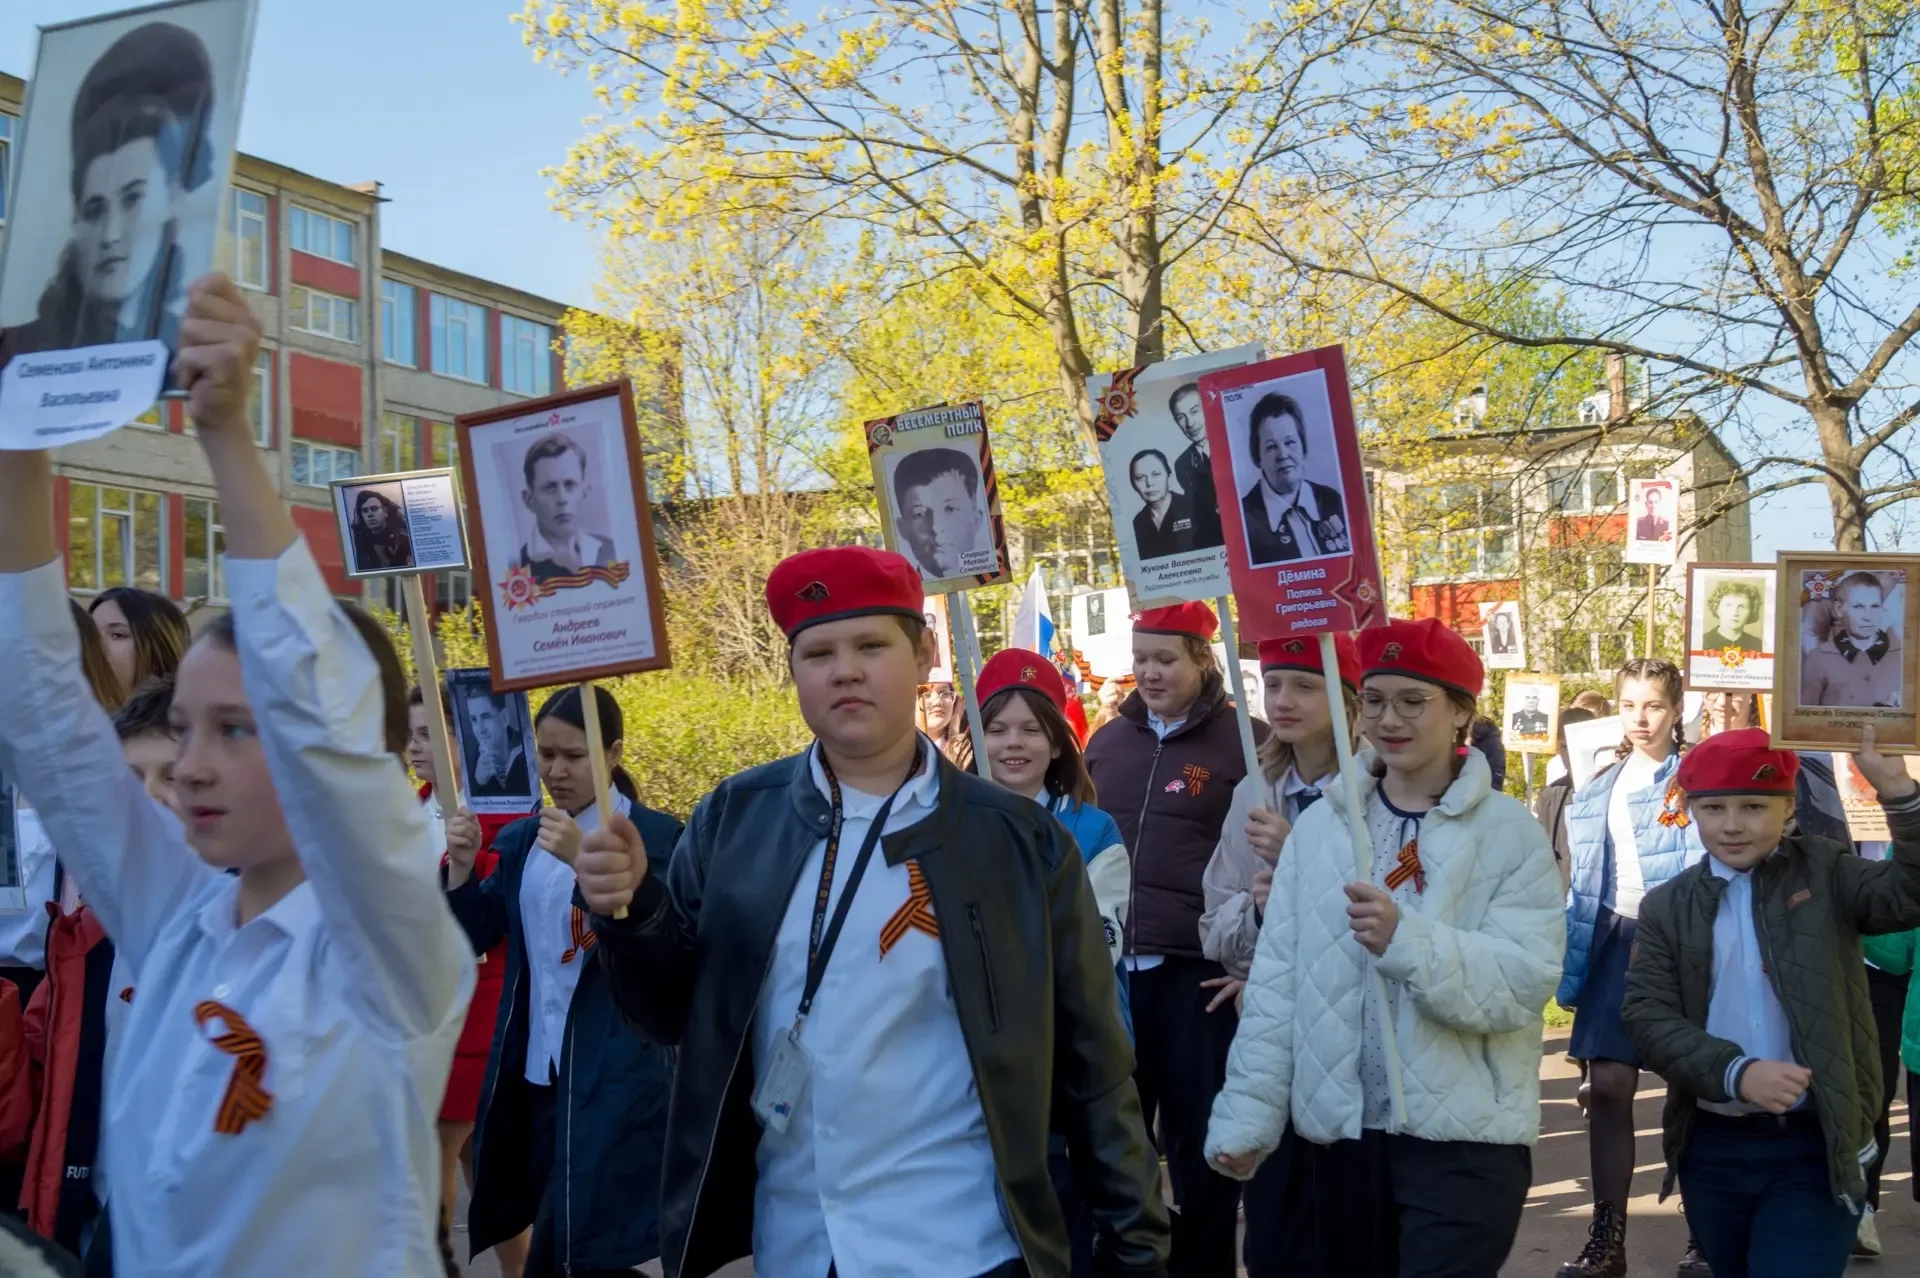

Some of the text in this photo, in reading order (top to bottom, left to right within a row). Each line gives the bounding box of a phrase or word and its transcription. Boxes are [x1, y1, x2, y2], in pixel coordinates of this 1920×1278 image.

[896, 405, 981, 431] БЕССМЕРТНЫЙ
[946, 421, 983, 437] ПОЛК
[1140, 564, 1169, 575] Жукова
[1171, 554, 1216, 568] Валентина
[1158, 567, 1202, 581] Алексеевна
[1277, 567, 1327, 586] Дёмина
[1286, 587, 1323, 600] Полина
[1275, 599, 1337, 616] Григорьевна
[552, 617, 600, 635] Андреев
[533, 637, 569, 652] Семён
[571, 628, 627, 646] Иванович
